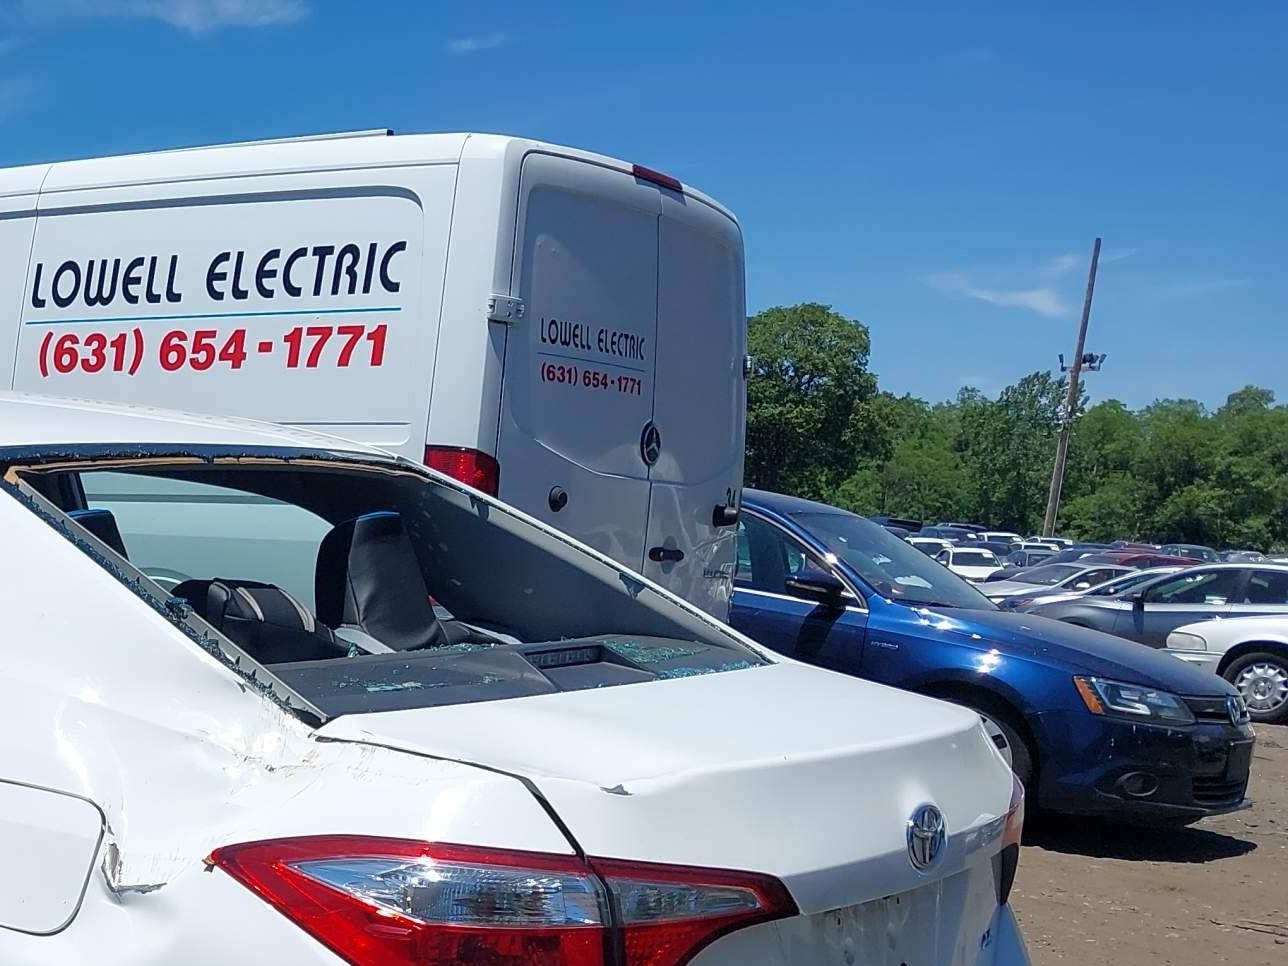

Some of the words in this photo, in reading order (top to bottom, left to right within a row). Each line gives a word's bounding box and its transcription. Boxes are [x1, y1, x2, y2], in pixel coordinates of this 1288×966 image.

[31, 253, 182, 308] LOWELL
[206, 240, 407, 301] ELECTRIC
[39, 327, 145, 378] (631)
[540, 317, 592, 350] LOWELL
[597, 328, 646, 361] ELECTRIC
[541, 361, 578, 387] (631)
